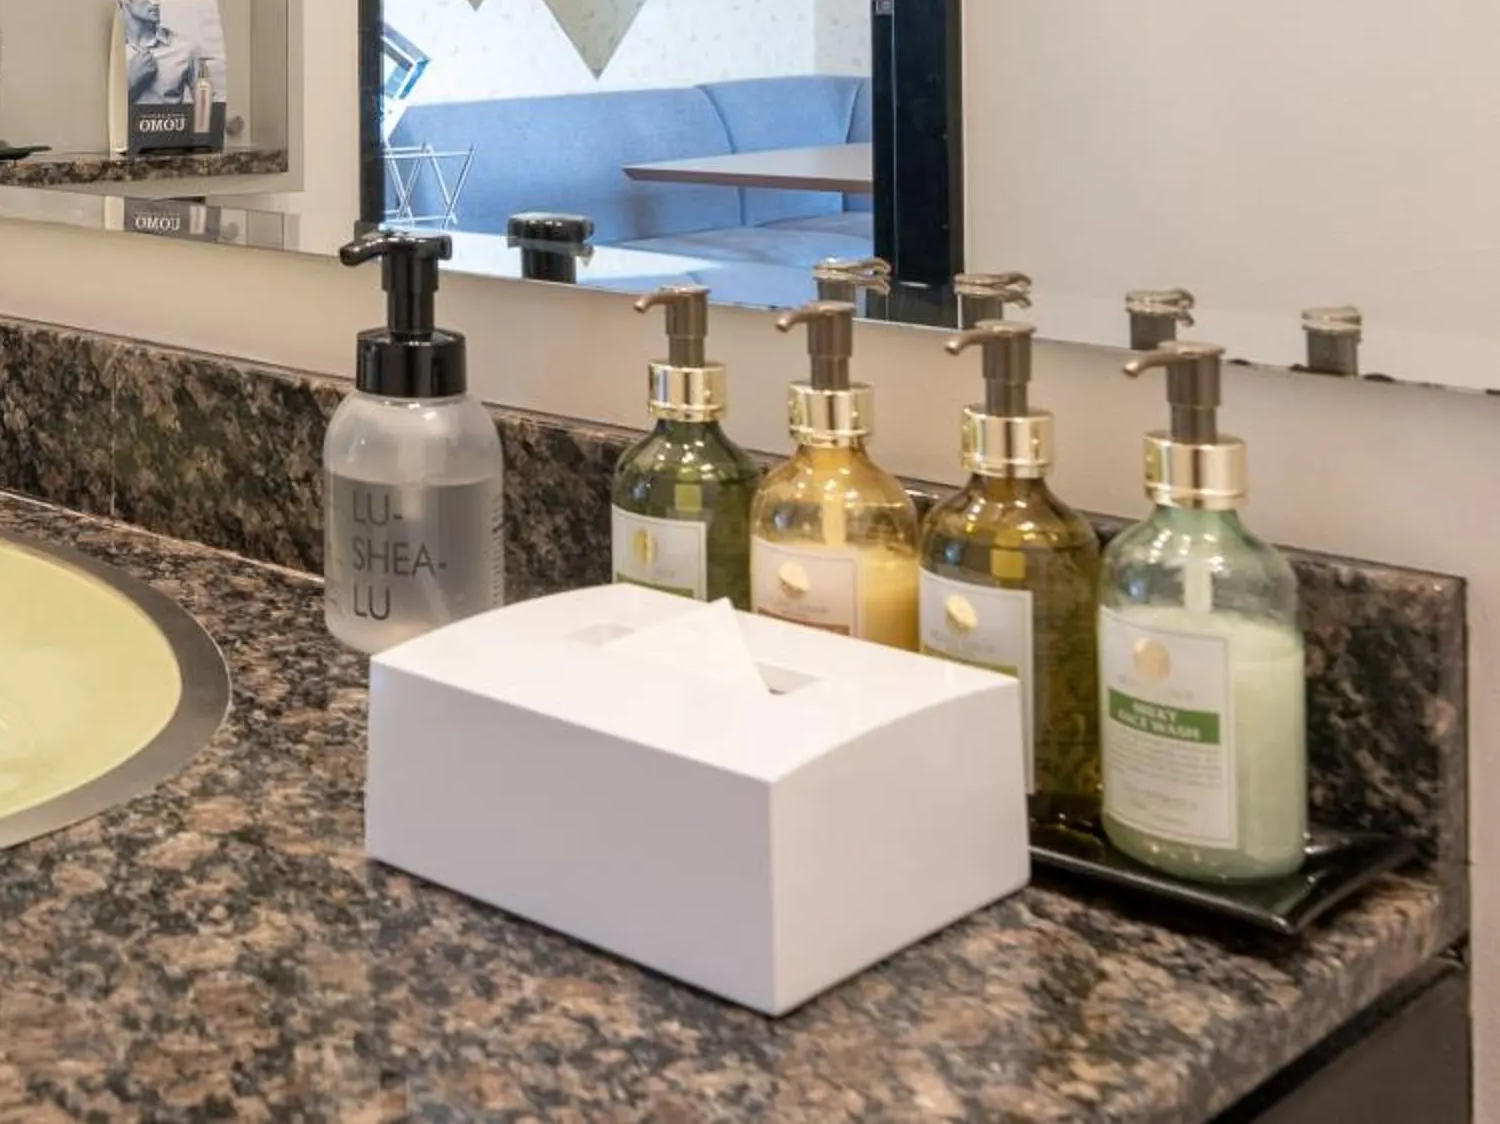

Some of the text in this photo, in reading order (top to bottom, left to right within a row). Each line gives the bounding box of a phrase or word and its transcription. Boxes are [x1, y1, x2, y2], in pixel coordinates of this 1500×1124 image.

[353, 490, 403, 527] LU-
[352, 536, 447, 578] SHEA-
[354, 584, 390, 620] LU
